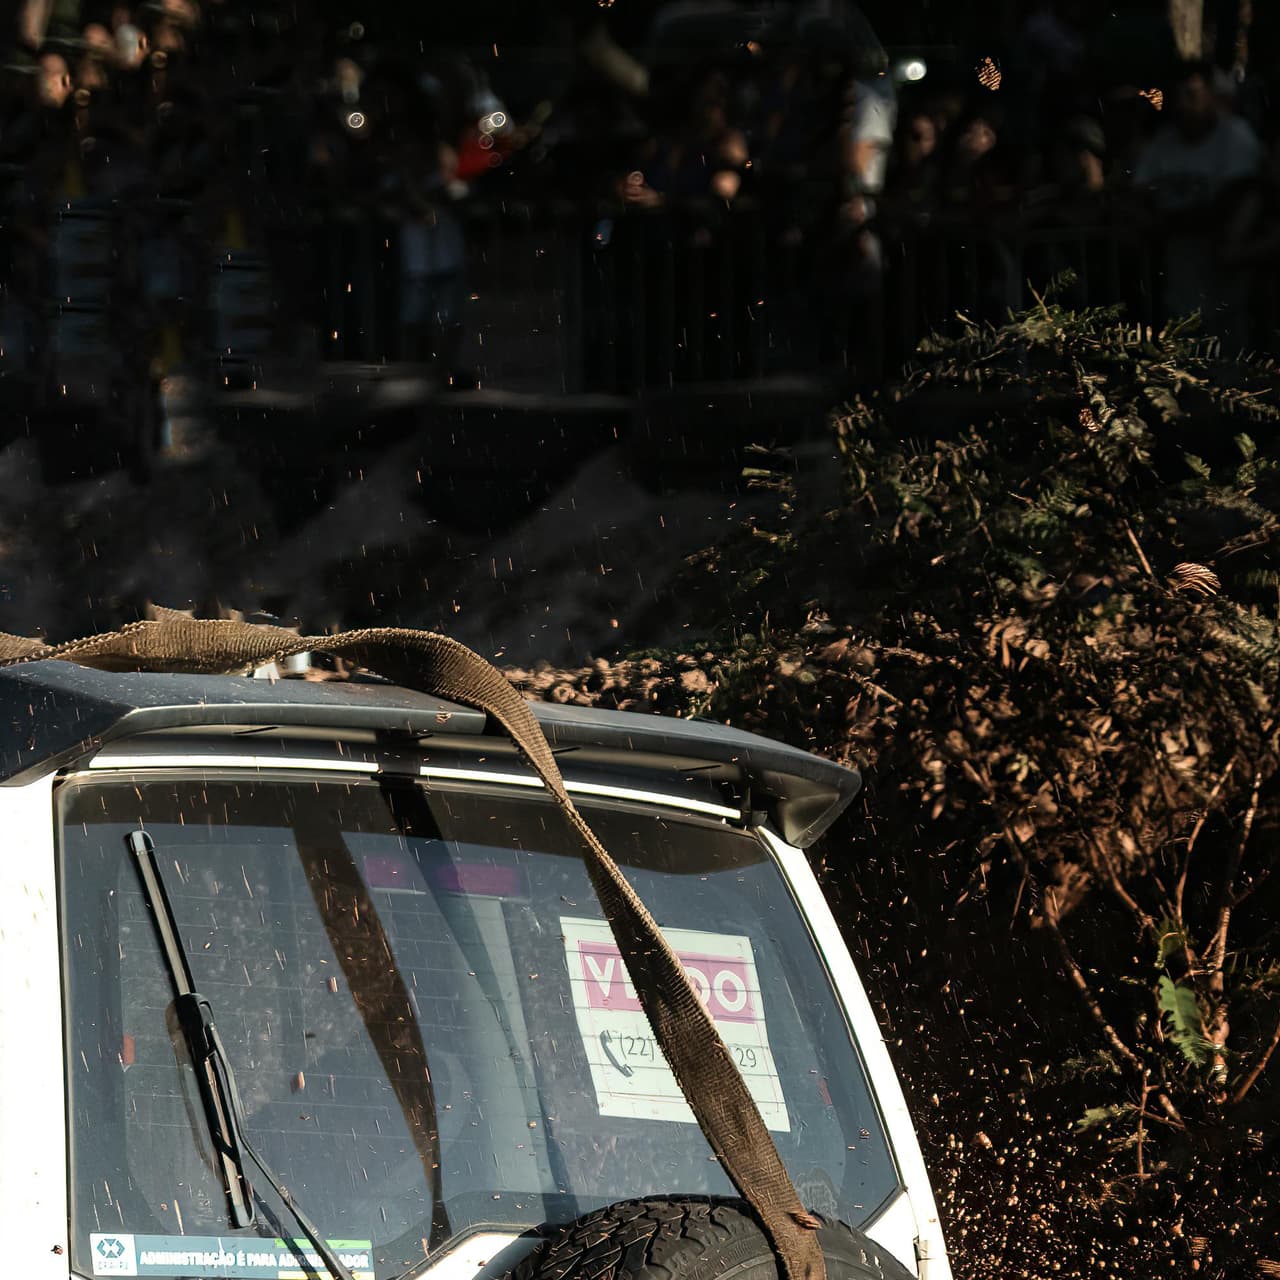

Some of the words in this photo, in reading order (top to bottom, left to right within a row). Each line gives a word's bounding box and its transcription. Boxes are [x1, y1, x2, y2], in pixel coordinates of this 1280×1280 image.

[140, 1250, 235, 1268] ADMINISTRAÇÃO
[237, 1250, 245, 1267] É
[247, 1252, 277, 1267] PARA
